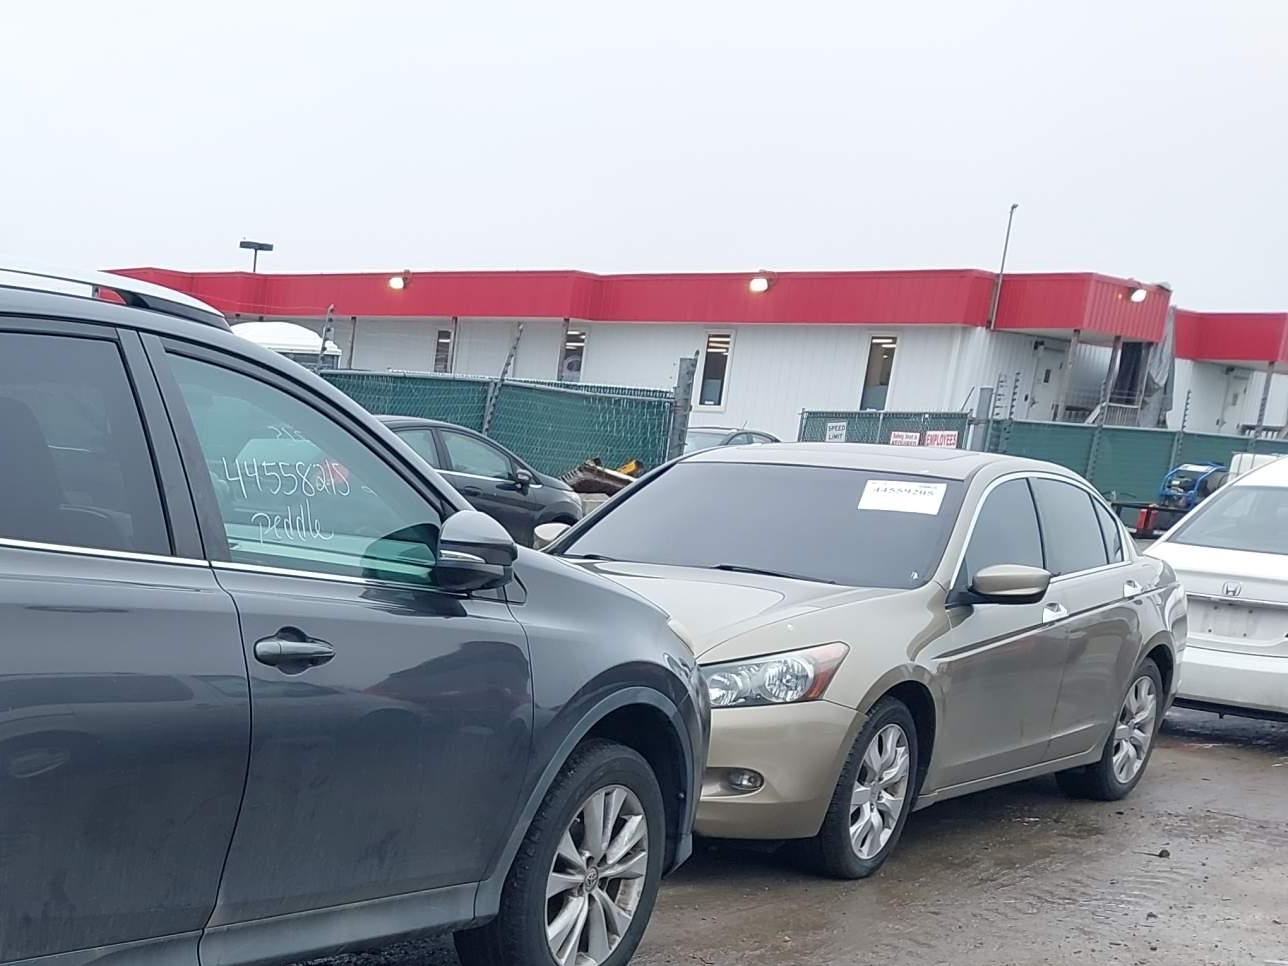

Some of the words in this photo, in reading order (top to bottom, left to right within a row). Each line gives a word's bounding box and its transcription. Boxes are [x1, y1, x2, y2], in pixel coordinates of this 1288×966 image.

[828, 424, 846, 432] SPEED
[828, 433, 844, 441] LIMIT
[926, 433, 957, 446] EMPLOYEES
[222, 457, 351, 499] 44558215
